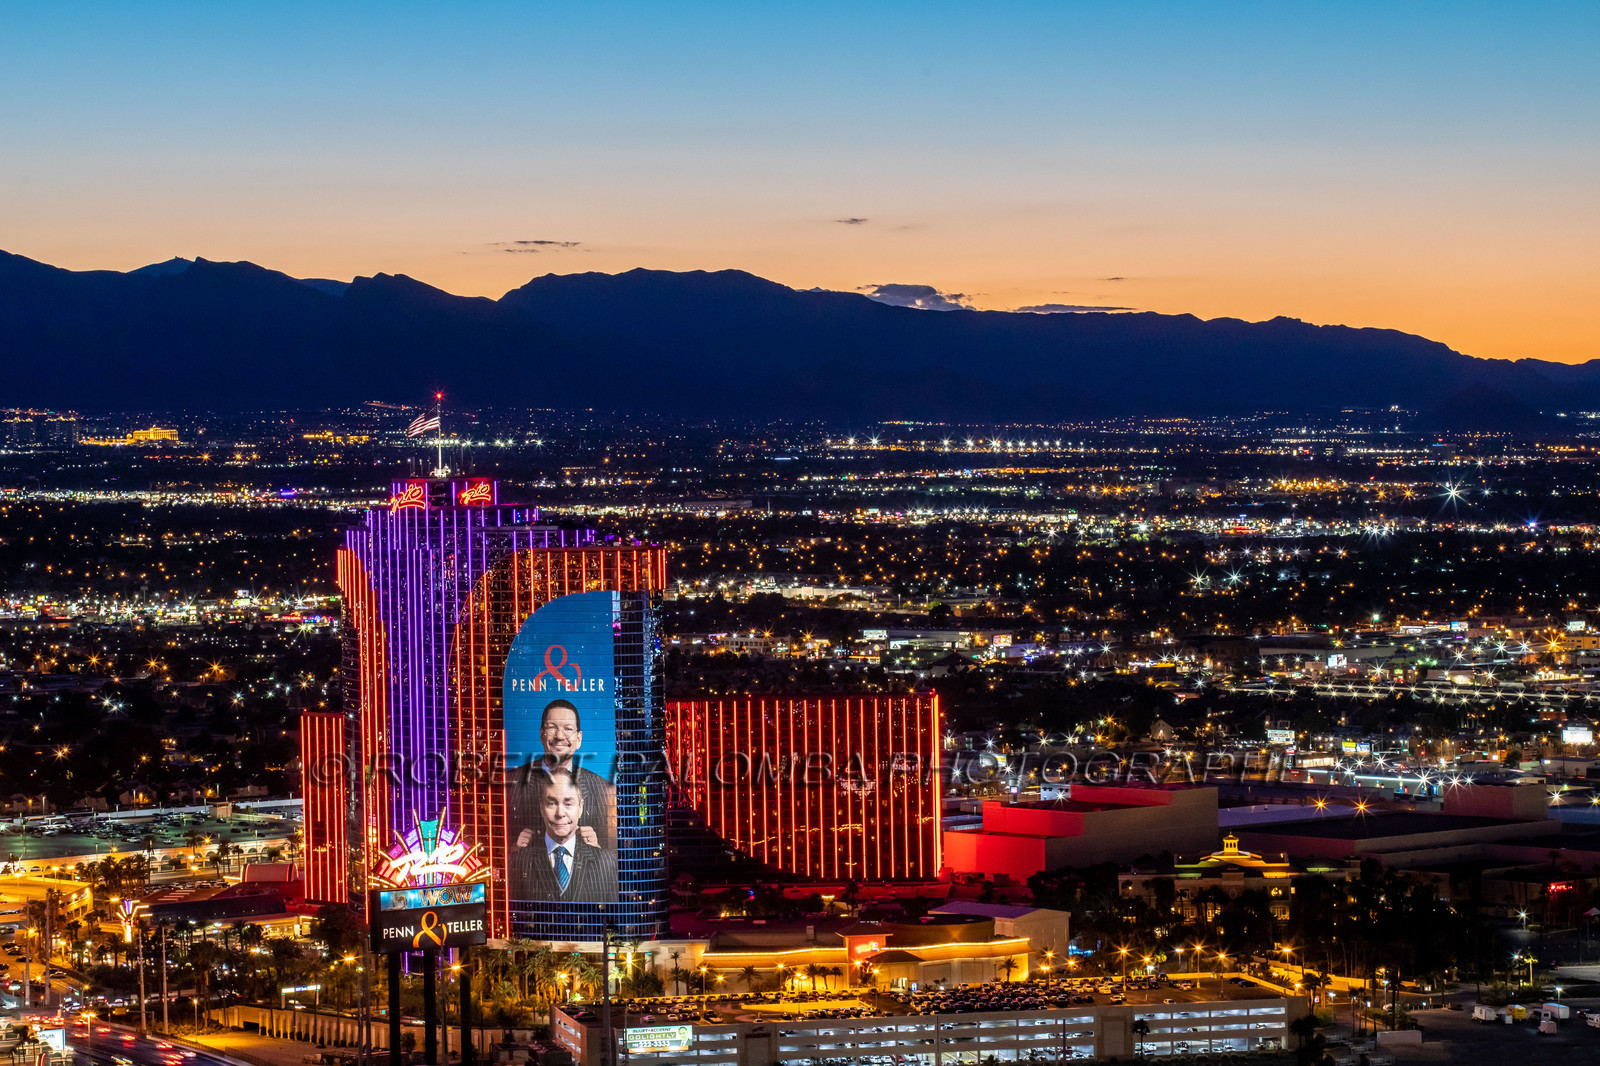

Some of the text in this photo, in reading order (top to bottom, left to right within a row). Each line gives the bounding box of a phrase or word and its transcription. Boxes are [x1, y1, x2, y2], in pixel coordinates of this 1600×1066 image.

[512, 678, 547, 692] PENN
[556, 678, 605, 692] TELLER
[419, 885, 473, 906] WOW
[383, 911, 483, 948] PENN & TELLER
